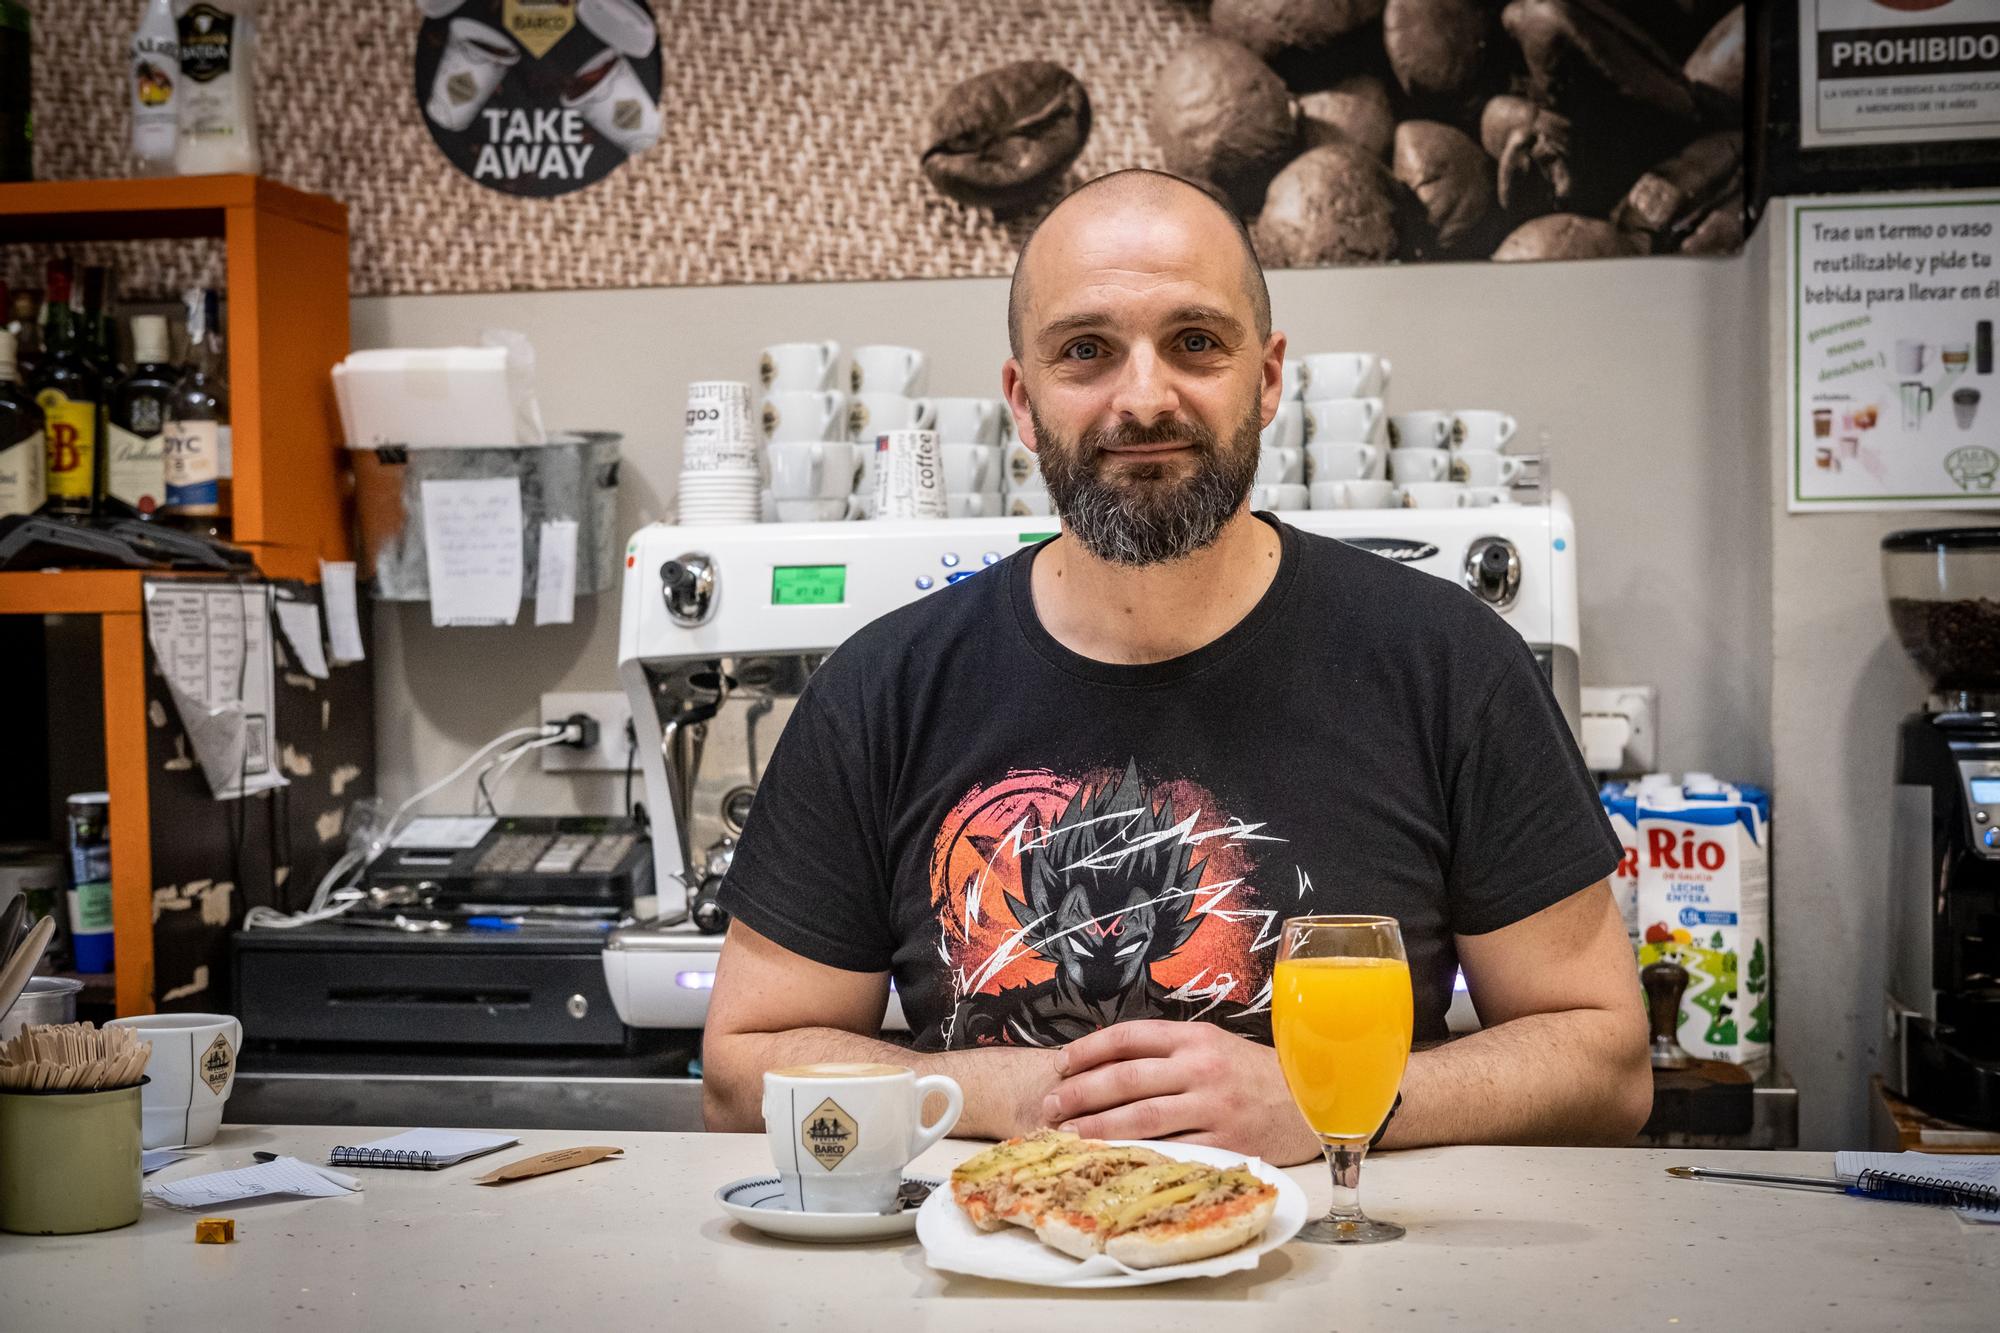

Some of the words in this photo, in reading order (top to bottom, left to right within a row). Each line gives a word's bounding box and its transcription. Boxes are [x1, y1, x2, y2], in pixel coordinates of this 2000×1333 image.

[1831, 34, 2000, 67] PROHIBIDO
[1840, 88, 1873, 98] VENTA
[1875, 87, 1889, 97] DE
[1892, 85, 1935, 96] BEBIDAS
[1865, 102, 1915, 113] MENORES
[1918, 102, 1930, 111] DE
[482, 108, 584, 144] TAKE
[474, 144, 594, 180] AWAY
[1813, 223, 1850, 242] Trae
[1854, 228, 1875, 241] un
[1879, 224, 1934, 240] termo
[1936, 226, 1948, 238] o
[1951, 222, 1992, 237] vaso
[1813, 252, 1912, 273] reutilizable
[1914, 257, 1927, 275] y
[1930, 252, 1967, 277] pide
[1971, 251, 1992, 268] tu
[1805, 284, 1862, 304] bebida
[1866, 288, 1904, 309] para
[1908, 282, 1957, 301] llevar
[1960, 285, 1981, 300] en
[1984, 279, 2000, 299] él
[916, 433, 935, 489] coffee
[1647, 828, 1725, 871] Río
[1666, 893, 1710, 904] ENTERA
[1671, 883, 1705, 893] LECHE
[814, 1144, 846, 1154] BARCO
